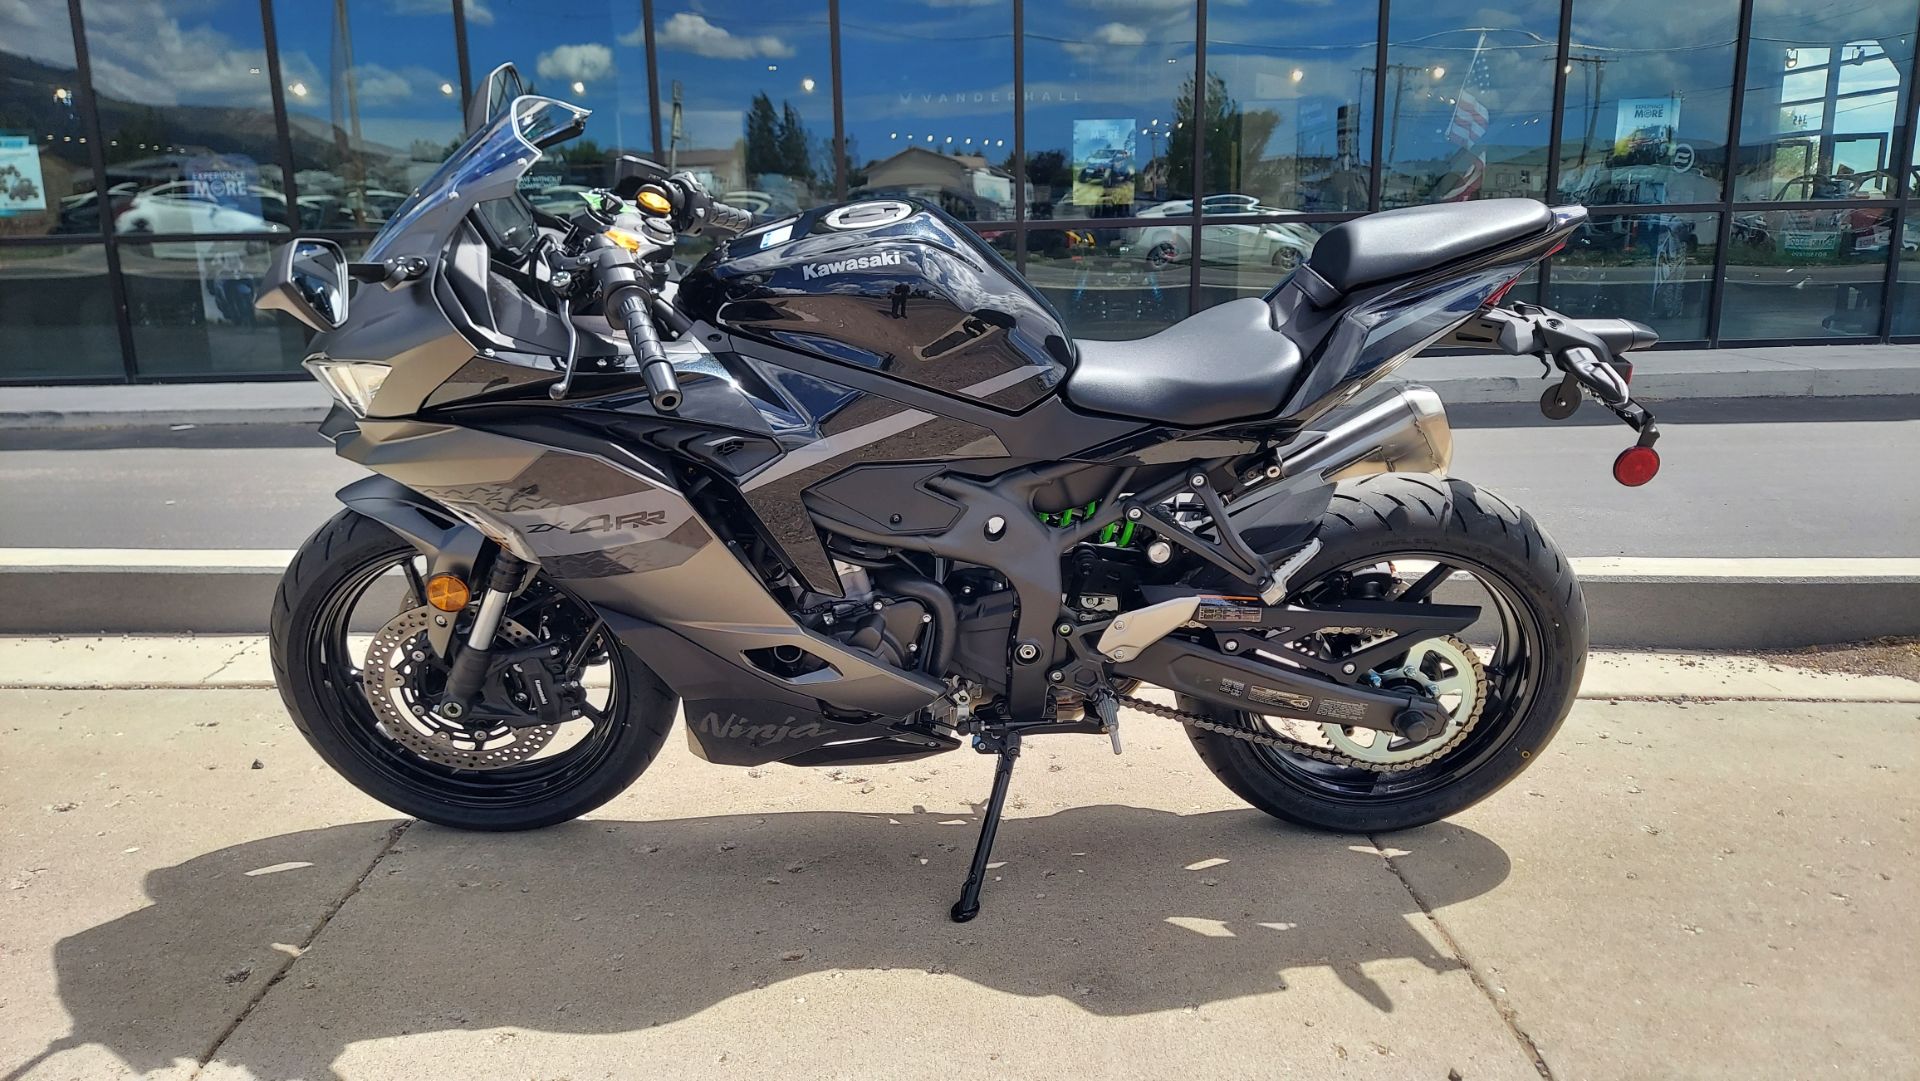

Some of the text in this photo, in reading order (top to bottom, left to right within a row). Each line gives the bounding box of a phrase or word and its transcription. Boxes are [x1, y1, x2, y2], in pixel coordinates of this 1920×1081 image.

[920, 92, 1082, 103] VANDERHALL
[1634, 109, 1664, 118] MORE
[192, 171, 246, 180] EXPERIENCE
[193, 180, 248, 196] MORE
[803, 251, 901, 281] Kawasaki
[699, 711, 838, 747] Ninja
